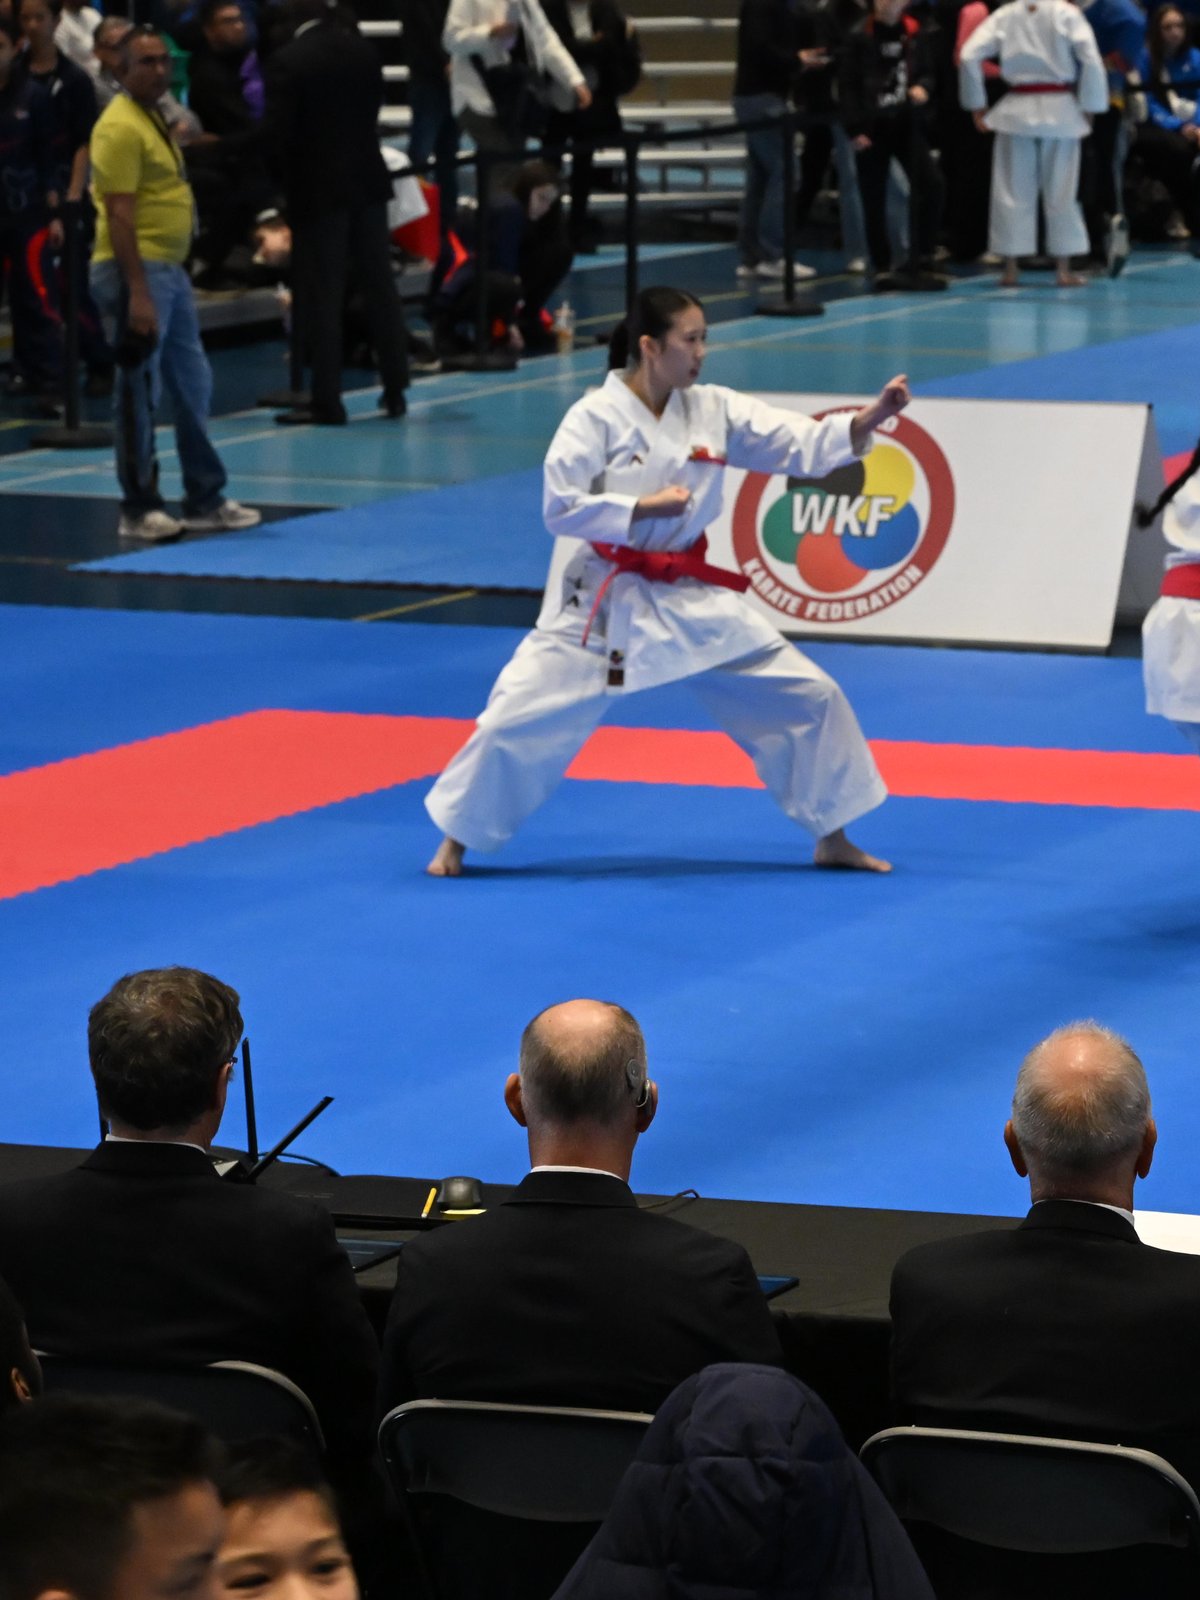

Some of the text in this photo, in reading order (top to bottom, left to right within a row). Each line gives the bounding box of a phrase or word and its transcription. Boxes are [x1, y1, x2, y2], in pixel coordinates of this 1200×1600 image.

[792, 493, 895, 537] WKF
[742, 557, 925, 621] KARATE FEDERATION
